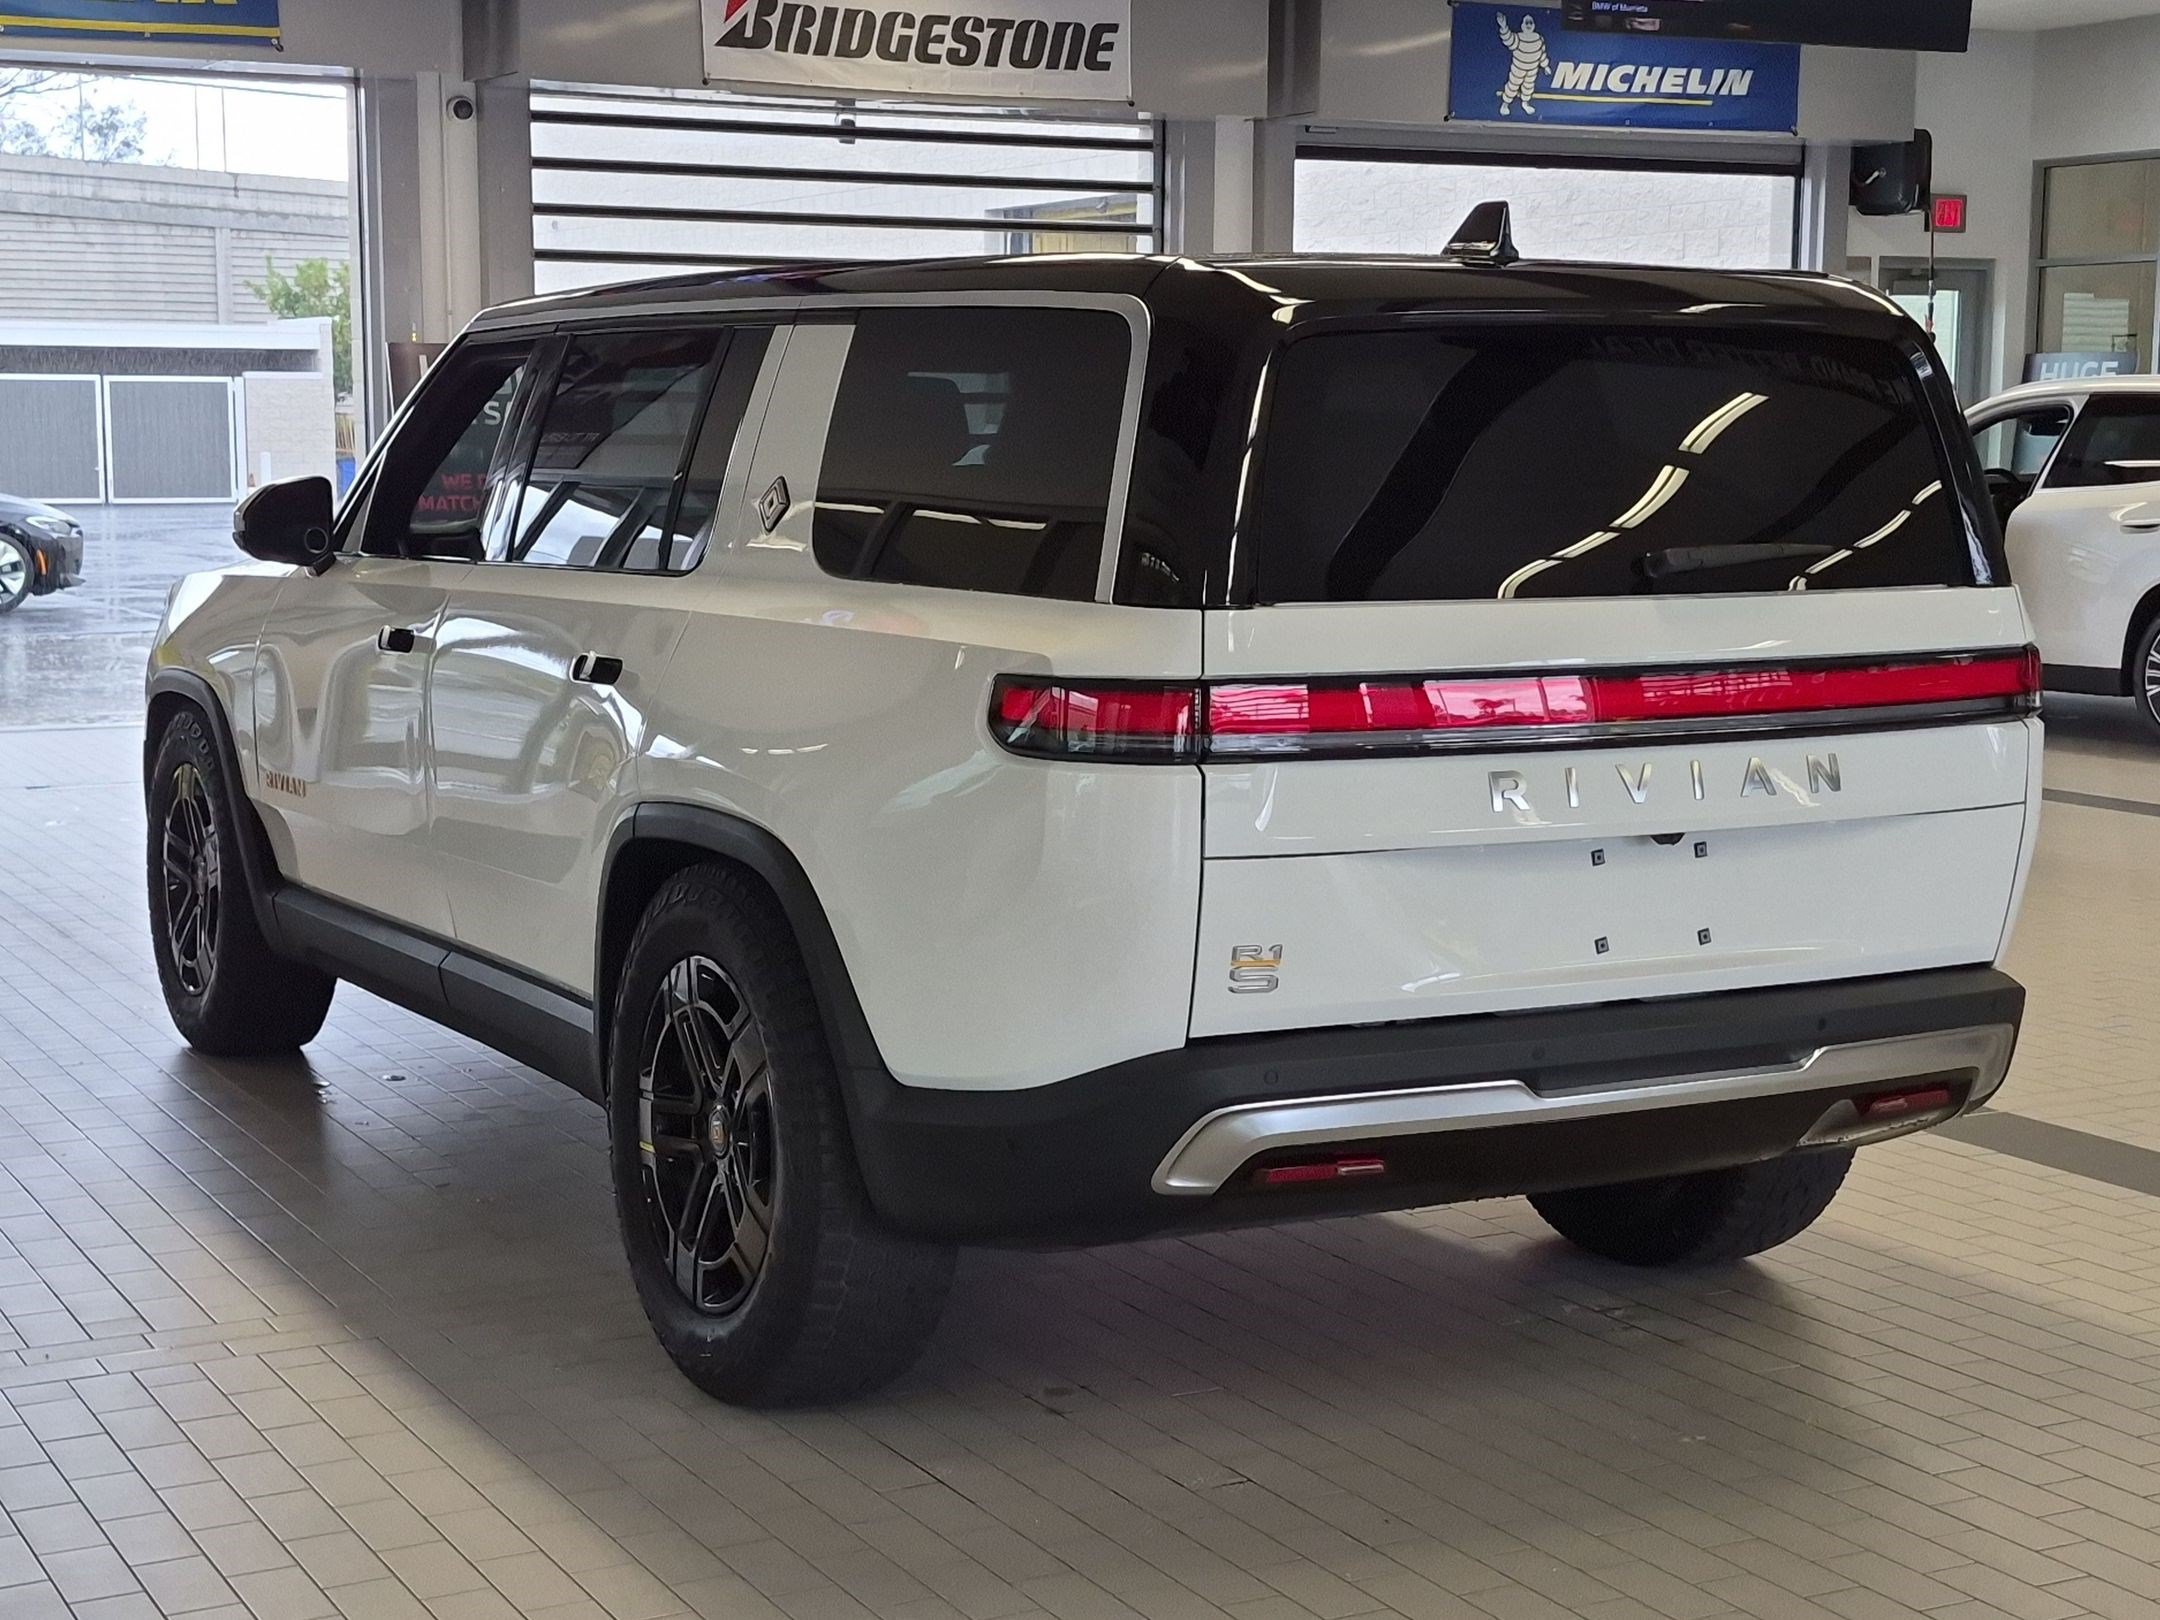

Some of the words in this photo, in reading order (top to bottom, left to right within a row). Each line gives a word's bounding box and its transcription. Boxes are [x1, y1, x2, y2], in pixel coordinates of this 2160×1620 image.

[714, 0, 1119, 72] BRIDGESTONE
[1551, 61, 1753, 97] MICHELIN
[441, 473, 472, 489] WE
[1487, 753, 1842, 813] RIVIAN
